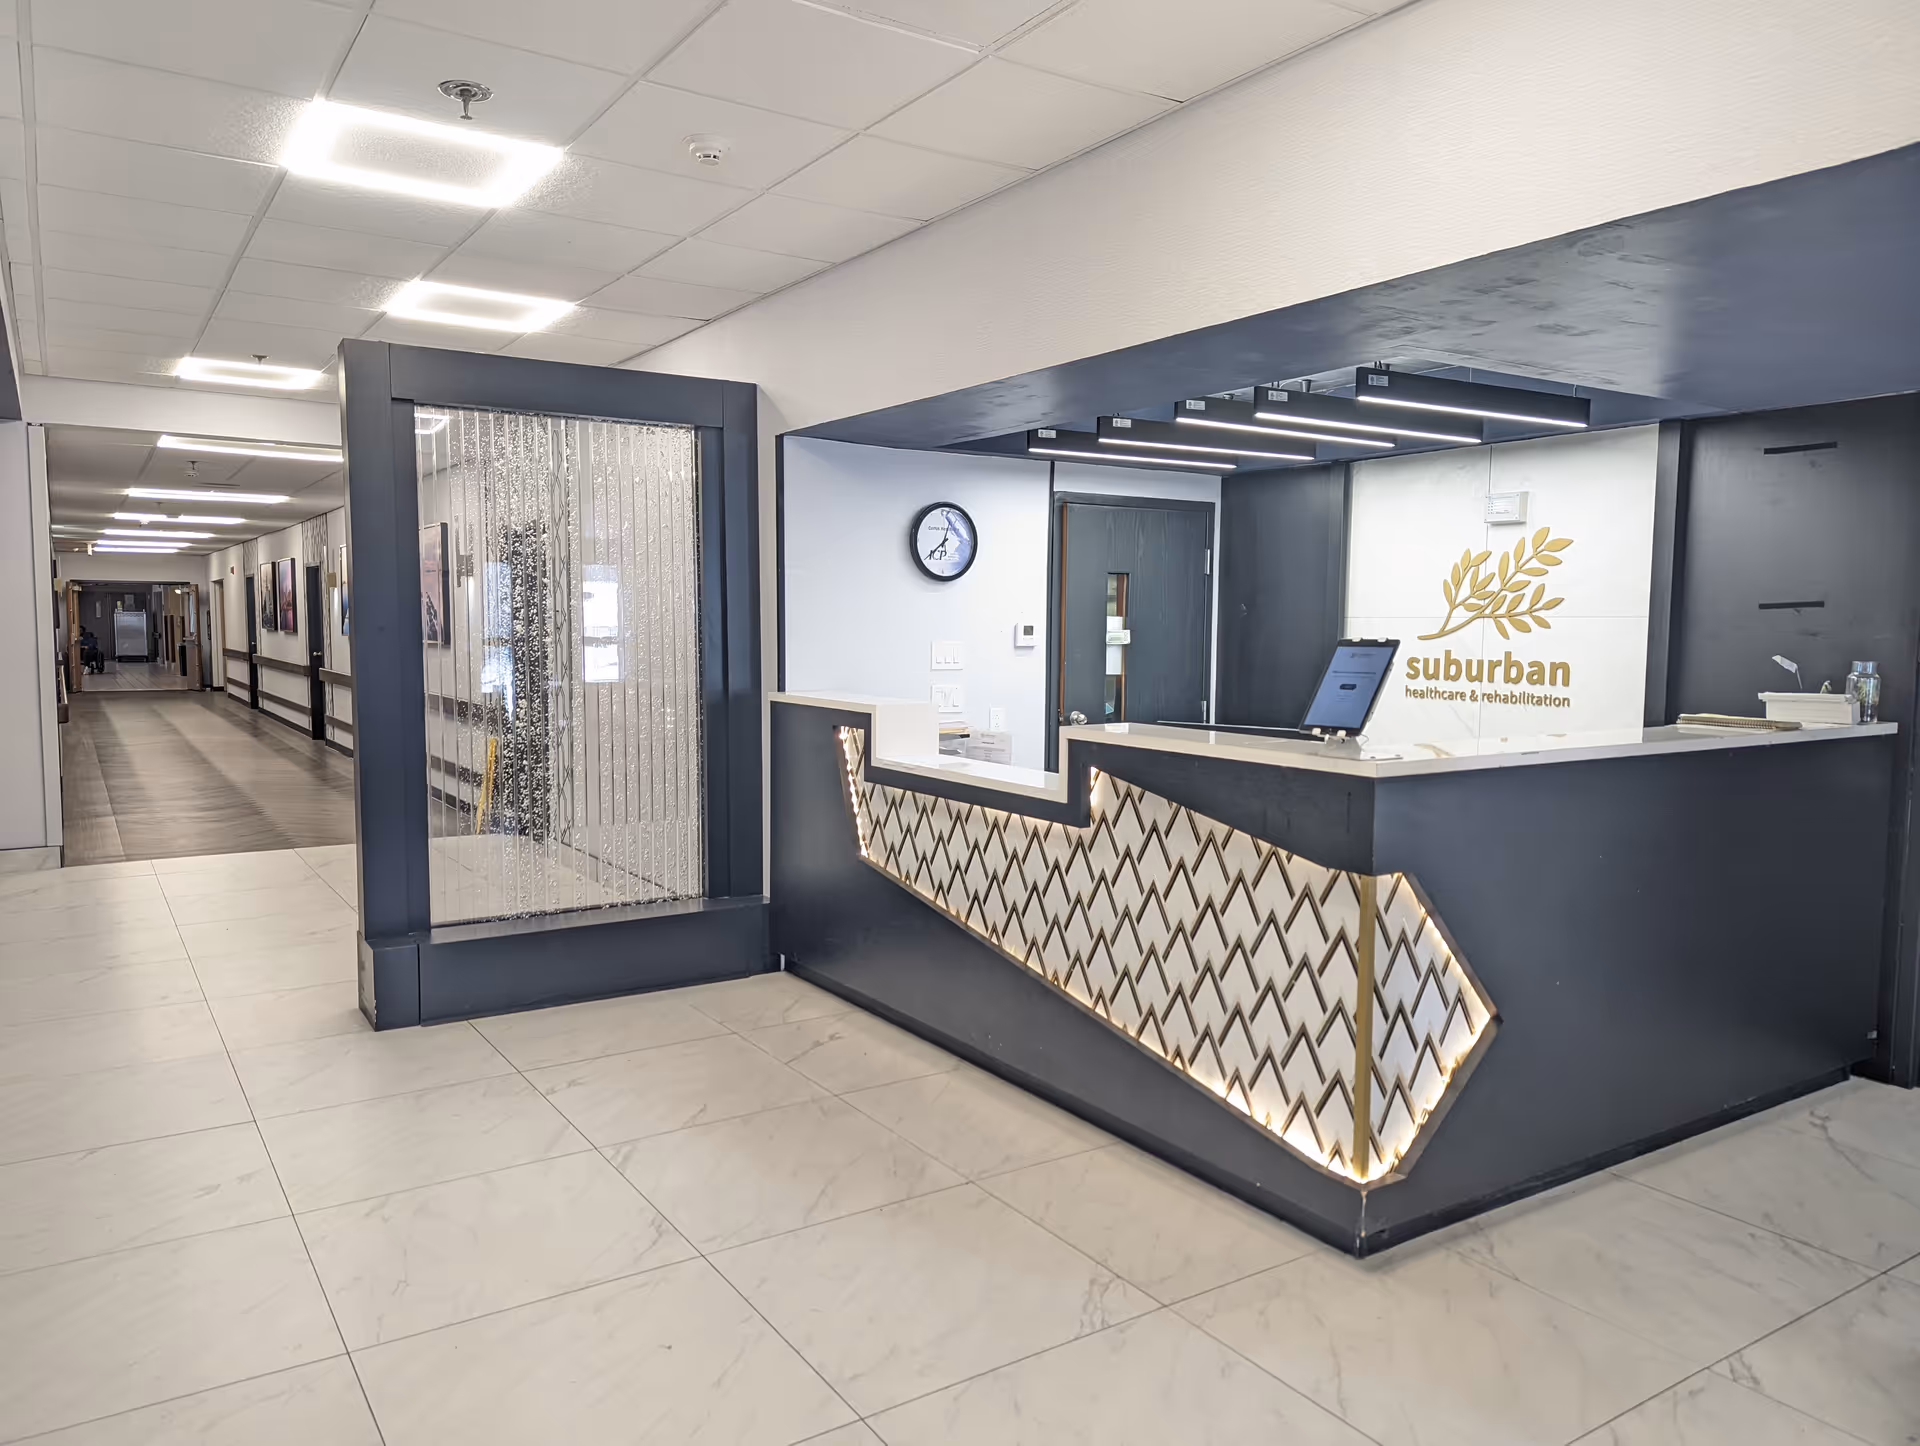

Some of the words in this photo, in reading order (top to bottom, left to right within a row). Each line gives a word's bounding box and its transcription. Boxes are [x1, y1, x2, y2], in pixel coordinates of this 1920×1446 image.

[1405, 650, 1570, 686] suburban
[1405, 685, 1467, 701] healthcare
[1469, 689, 1479, 702] &
[1481, 691, 1570, 707] rehabilitation
